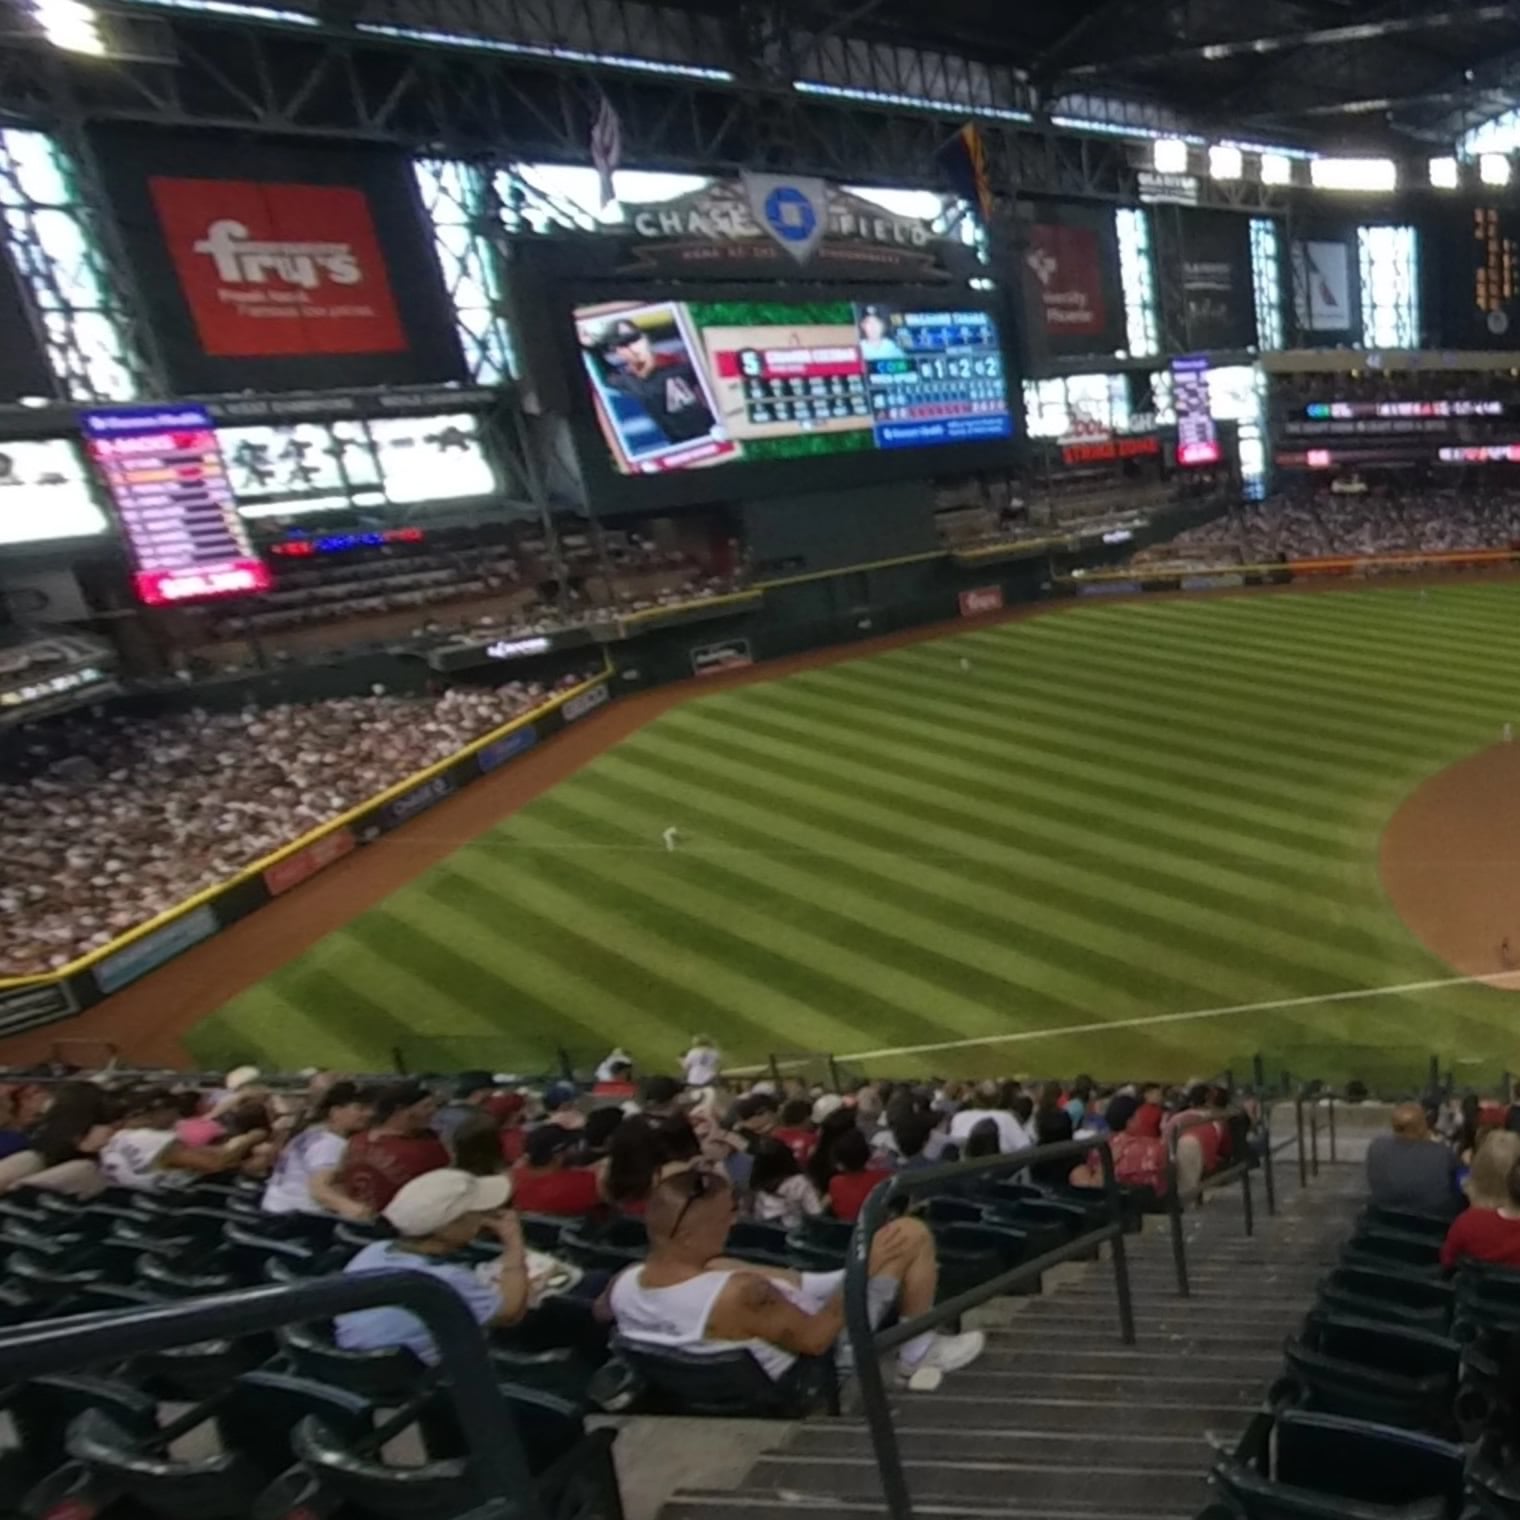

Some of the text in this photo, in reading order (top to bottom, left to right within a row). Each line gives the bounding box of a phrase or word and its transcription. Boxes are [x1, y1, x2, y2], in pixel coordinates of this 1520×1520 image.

[635, 209, 752, 237] CHASE
[193, 219, 363, 289] fry's
[959, 358, 972, 378] 2
[984, 356, 998, 377] 2
